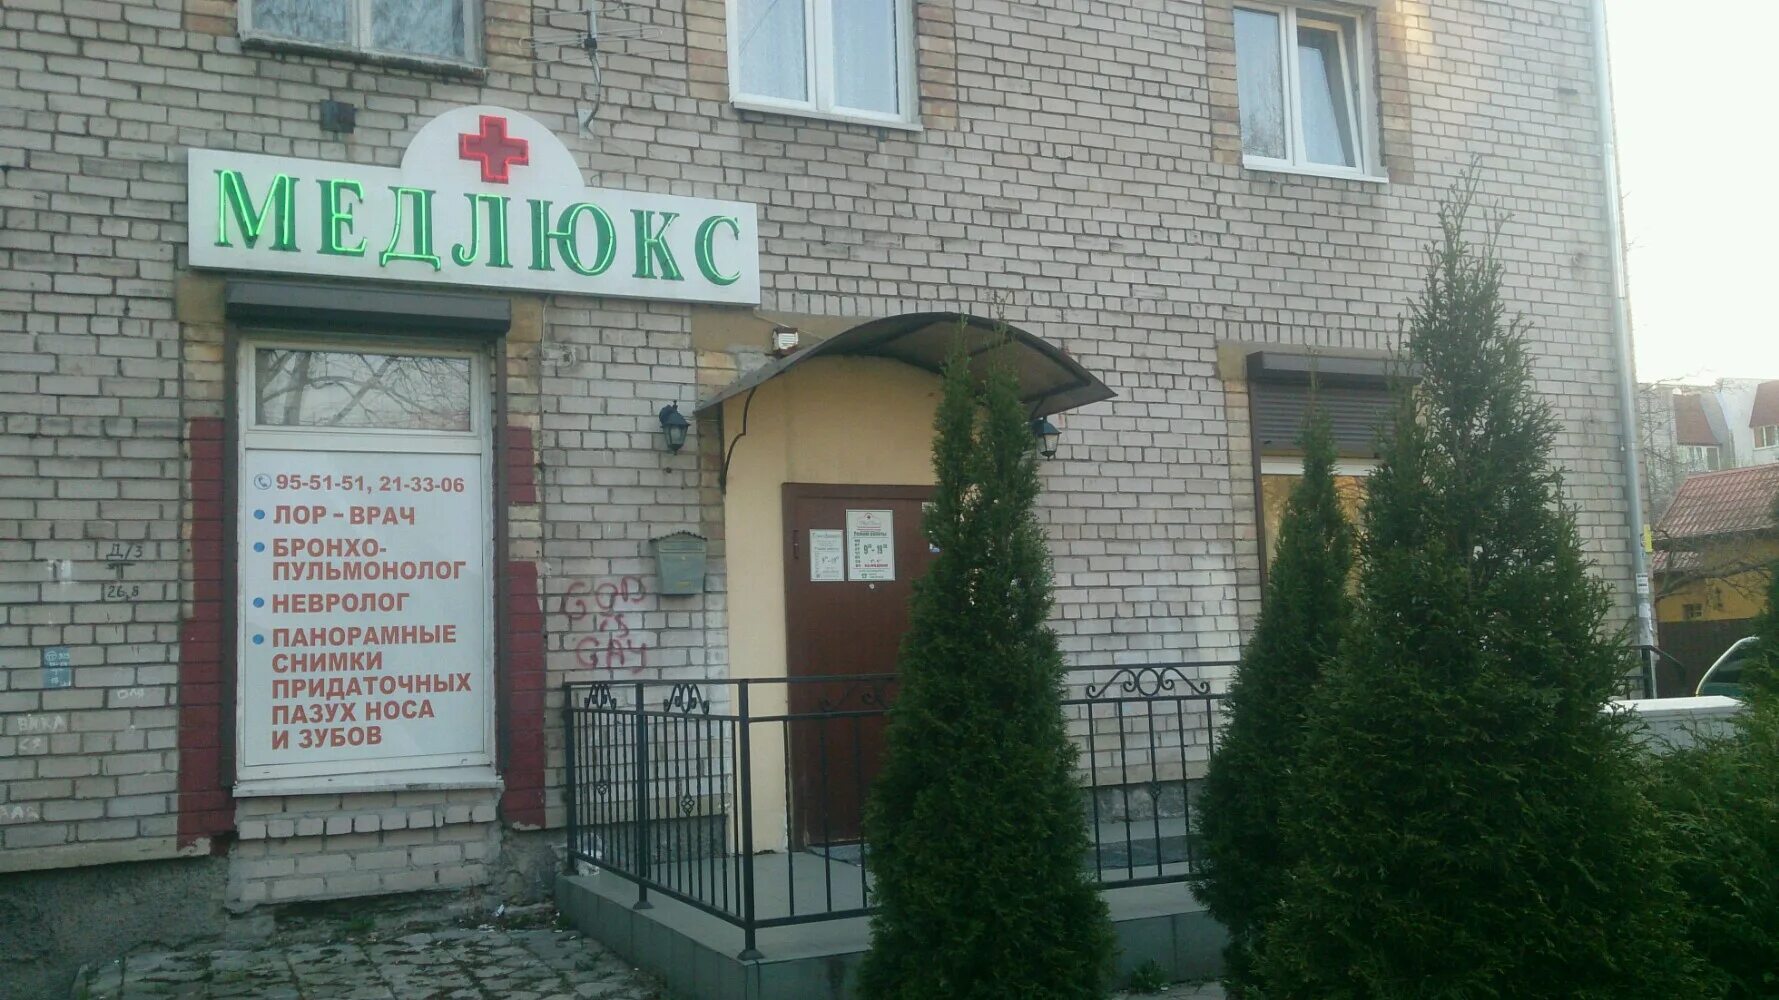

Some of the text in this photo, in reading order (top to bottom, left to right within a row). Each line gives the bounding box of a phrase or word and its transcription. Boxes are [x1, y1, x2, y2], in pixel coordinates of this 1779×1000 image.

[212, 169, 742, 287] МЕДЛЮКС
[276, 474, 465, 494] 95-51-51, 21-33-06
[273, 505, 327, 525] ЛОР
[350, 506, 415, 525] ВРАЧ
[272, 538, 387, 557] БРОНХО-
[272, 561, 466, 580] ПУЛЬМОНОЛОГ
[272, 593, 410, 614] НЕВРОЛОГ
[272, 624, 457, 648] ПАНОРАМНЫЕ
[271, 651, 383, 673] СНИМКИ
[271, 673, 472, 700] ПРИДАТОЧНЫХ
[271, 699, 435, 725] ПАЗУХ НОСА
[271, 726, 382, 750] И ЗУБОВ
